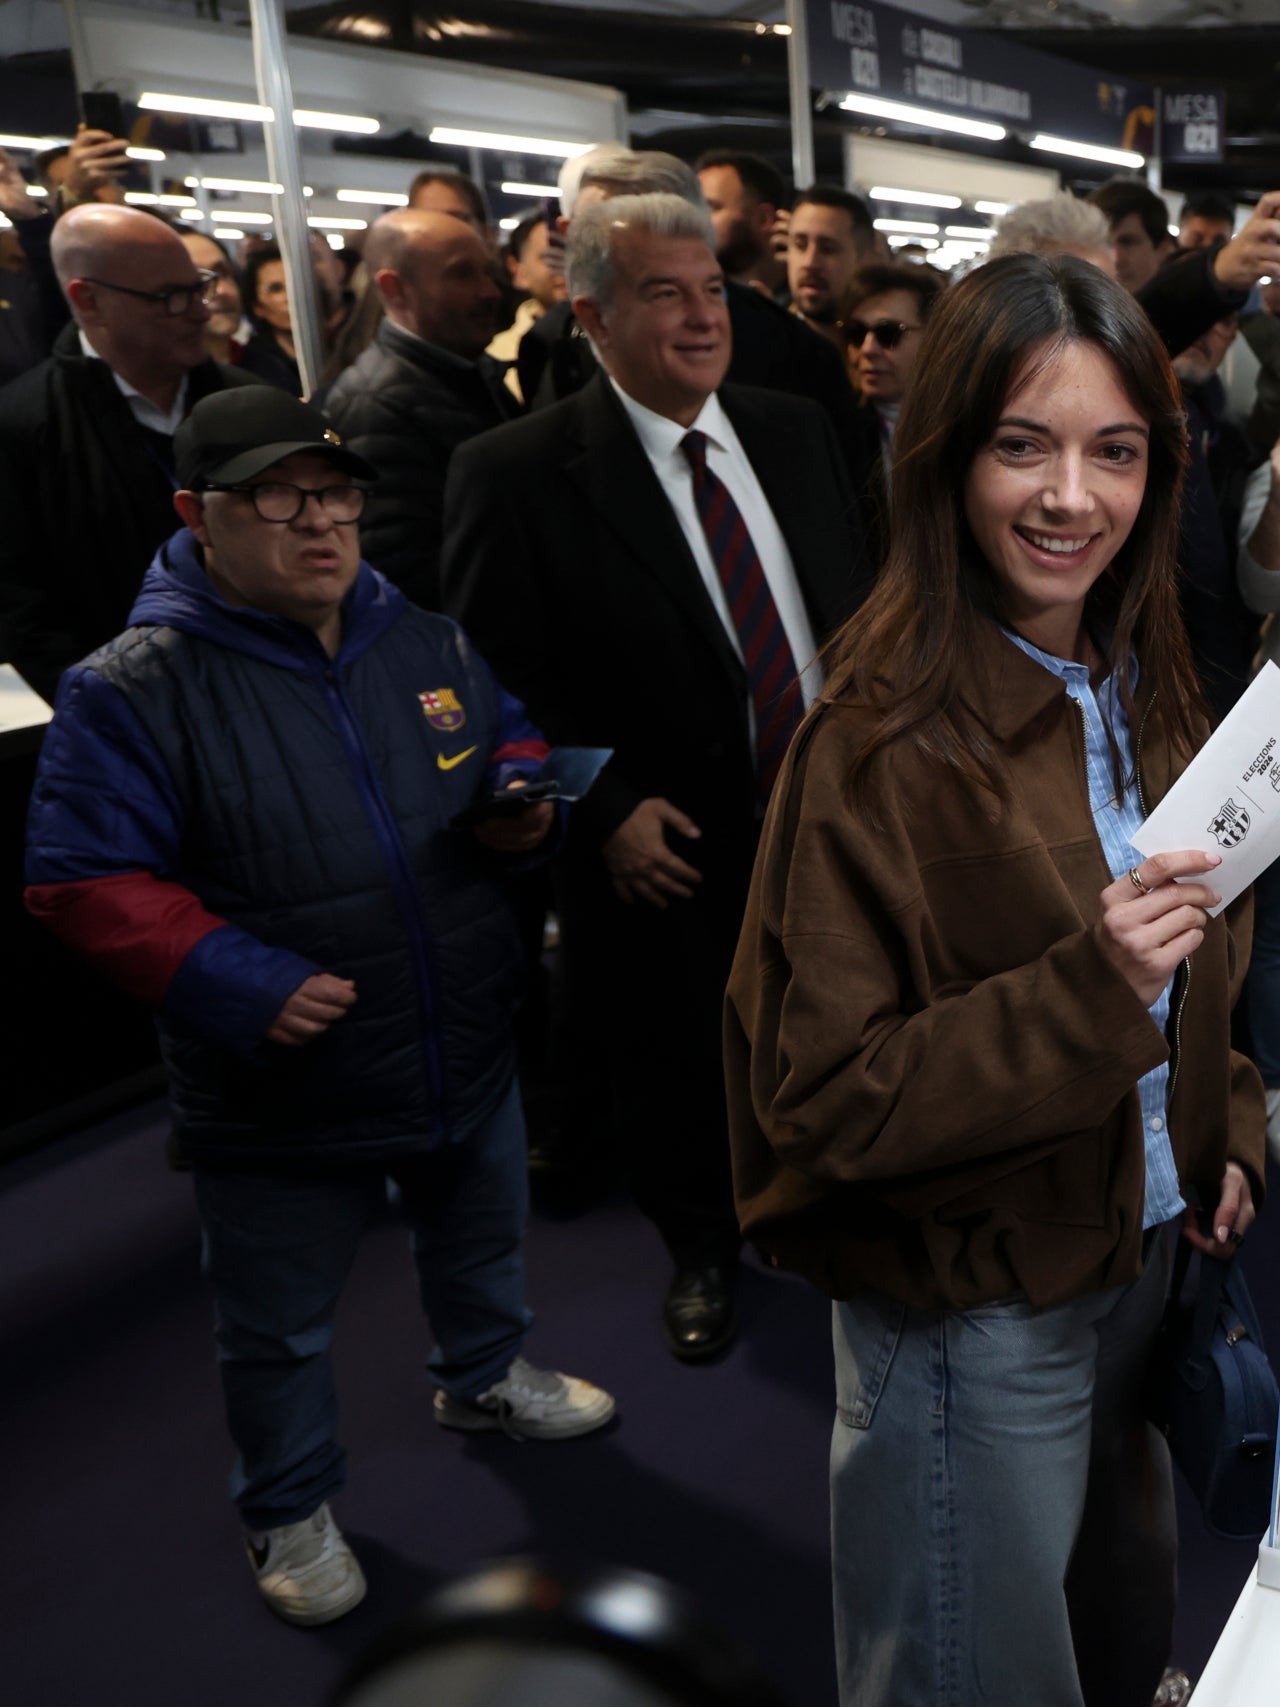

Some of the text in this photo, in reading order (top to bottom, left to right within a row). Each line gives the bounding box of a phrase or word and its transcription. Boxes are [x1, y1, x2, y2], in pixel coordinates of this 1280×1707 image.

[1164, 93, 1219, 126] MESA
[1242, 737, 1277, 783] ELECCIONS
[1257, 755, 1274, 776] 2026
